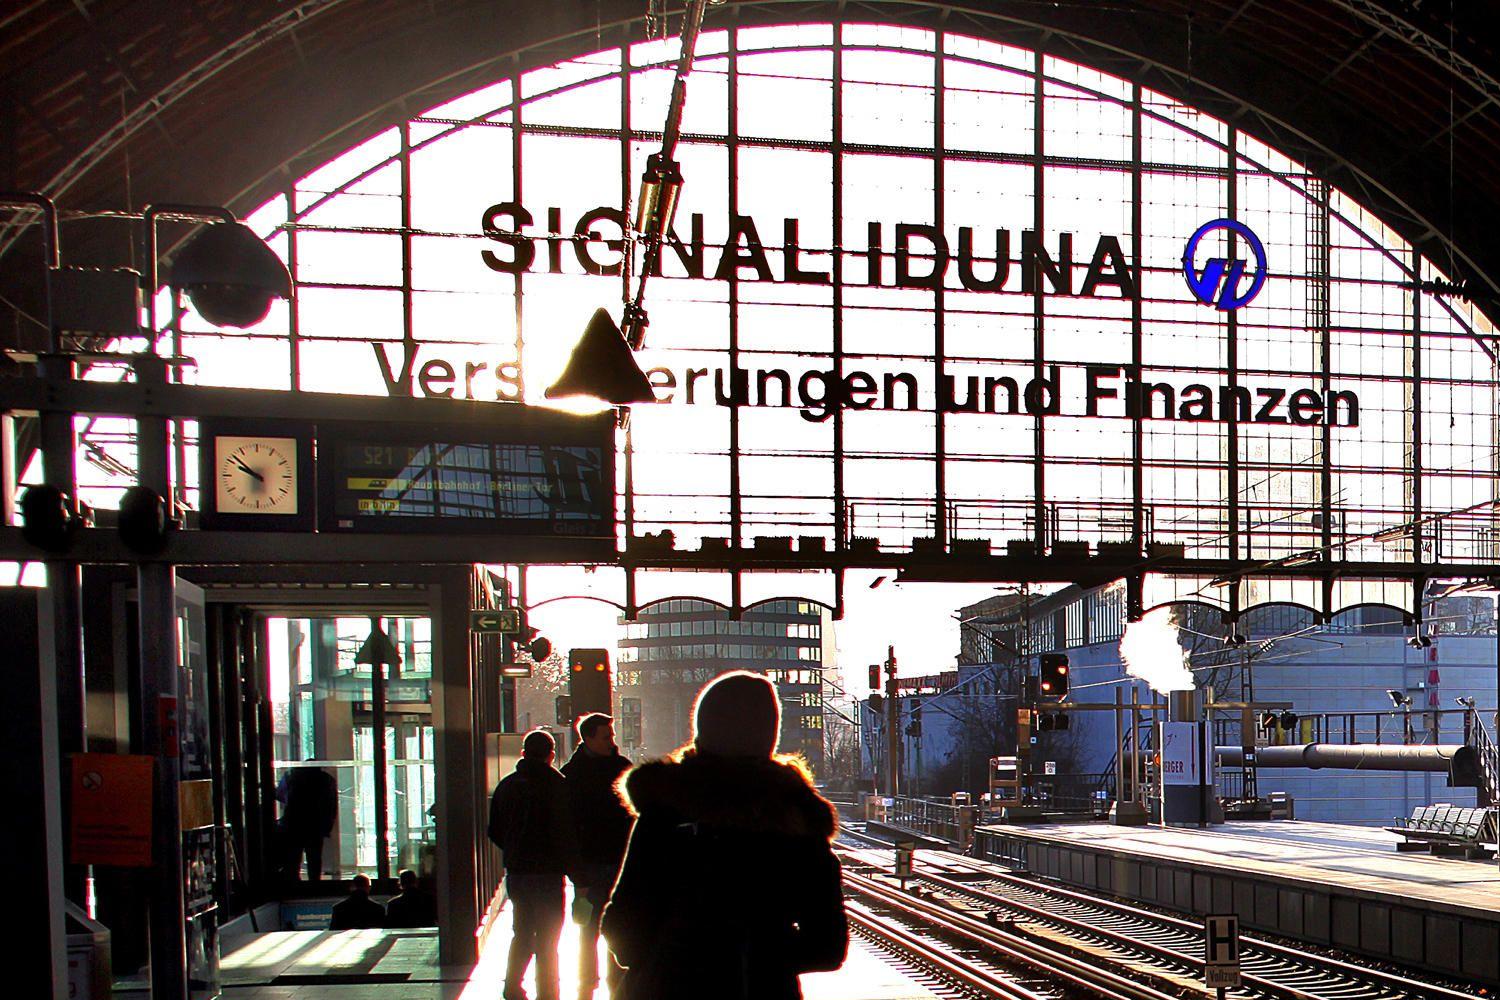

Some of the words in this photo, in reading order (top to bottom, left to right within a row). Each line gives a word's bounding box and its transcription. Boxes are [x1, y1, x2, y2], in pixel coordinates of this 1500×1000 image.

[481, 202, 831, 284] SIGNAL
[867, 221, 1137, 299] IDUNA
[372, 342, 918, 423] Verserungen
[943, 365, 1061, 416] und
[1086, 366, 1360, 427] Finanzen
[407, 480, 480, 491] Hauptbahnhof
[553, 521, 583, 535] Gleis
[1209, 919, 1235, 961] H
[1208, 969, 1238, 984] Vollzug
